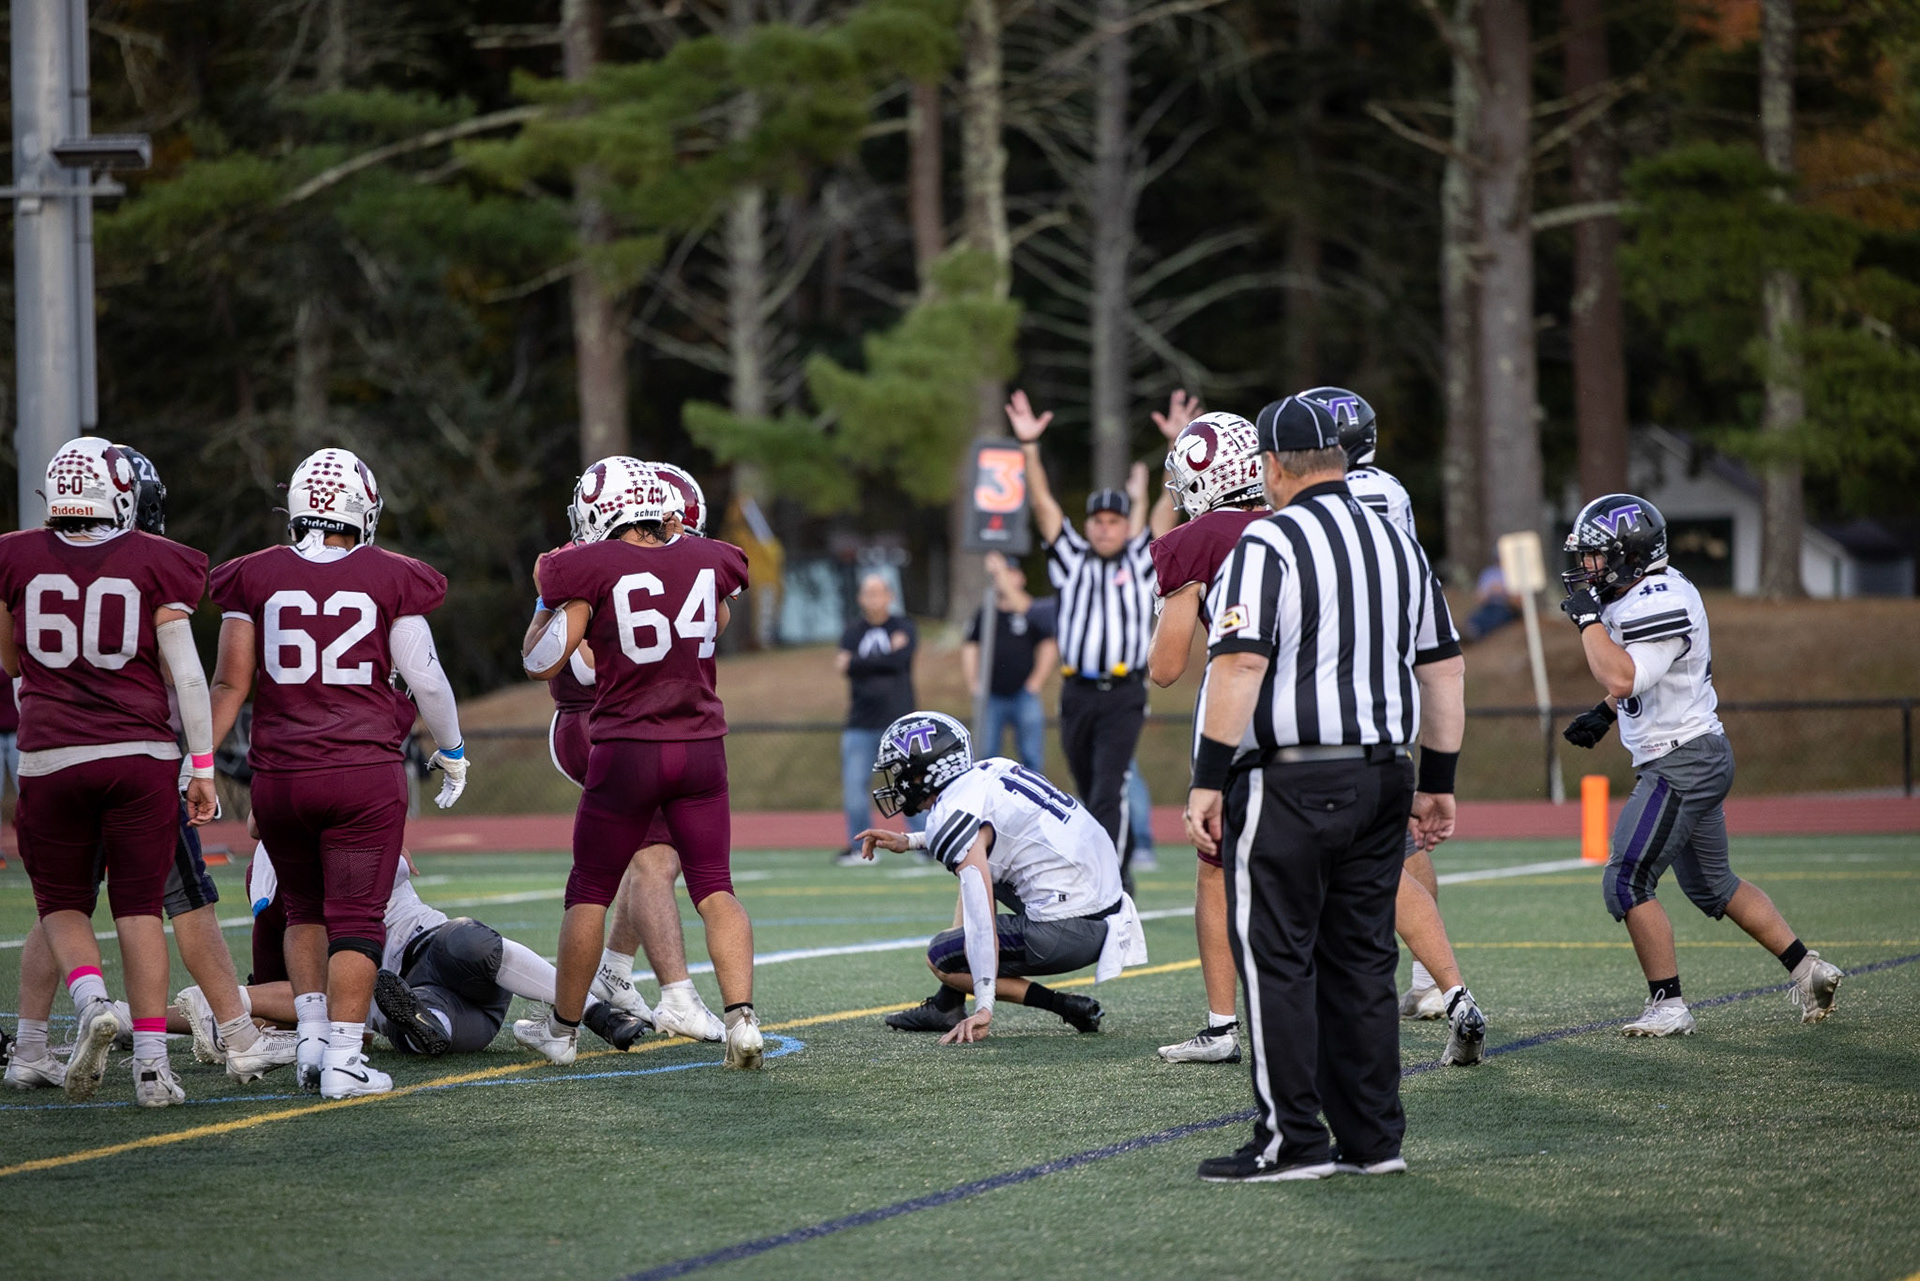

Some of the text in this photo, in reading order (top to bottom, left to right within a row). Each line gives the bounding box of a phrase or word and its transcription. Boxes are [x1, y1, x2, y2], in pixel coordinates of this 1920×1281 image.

[57, 475, 83, 495] 60
[633, 486, 656, 505] 64
[975, 448, 1025, 512] 3
[51, 505, 94, 517] Riddell
[309, 489, 335, 512] 62
[1591, 503, 1642, 540] VT
[25, 573, 142, 671] 60
[612, 568, 718, 665] 64
[264, 590, 378, 685] 62
[890, 723, 938, 760] VT
